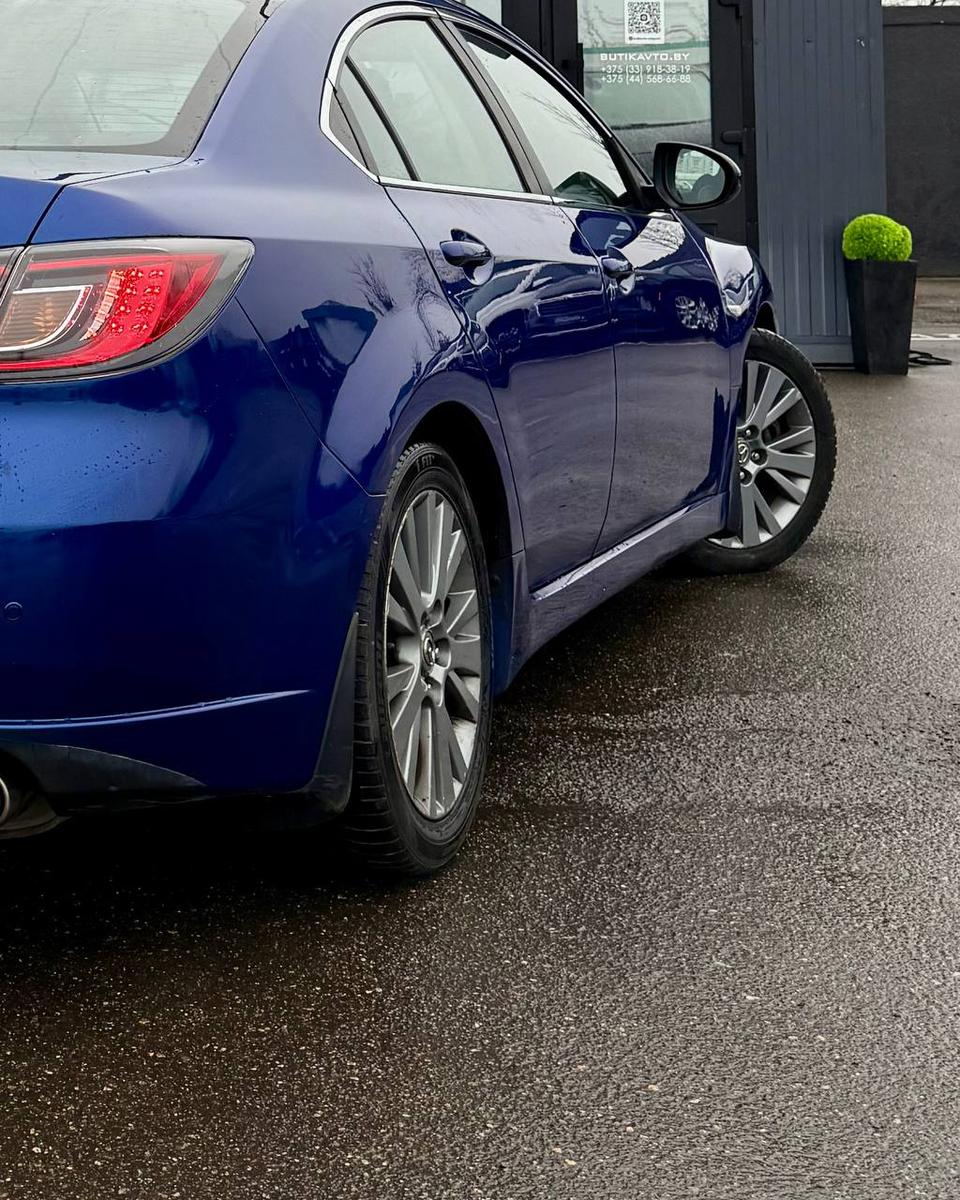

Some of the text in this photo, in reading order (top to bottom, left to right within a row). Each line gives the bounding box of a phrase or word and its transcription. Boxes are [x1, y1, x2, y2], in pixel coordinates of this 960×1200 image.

[600, 52, 690, 61] BUTIKAVTO.BY
[601, 64, 691, 75] +375 (33) 918-38-19
[601, 74, 691, 85] +375 (44) 568-66-88
